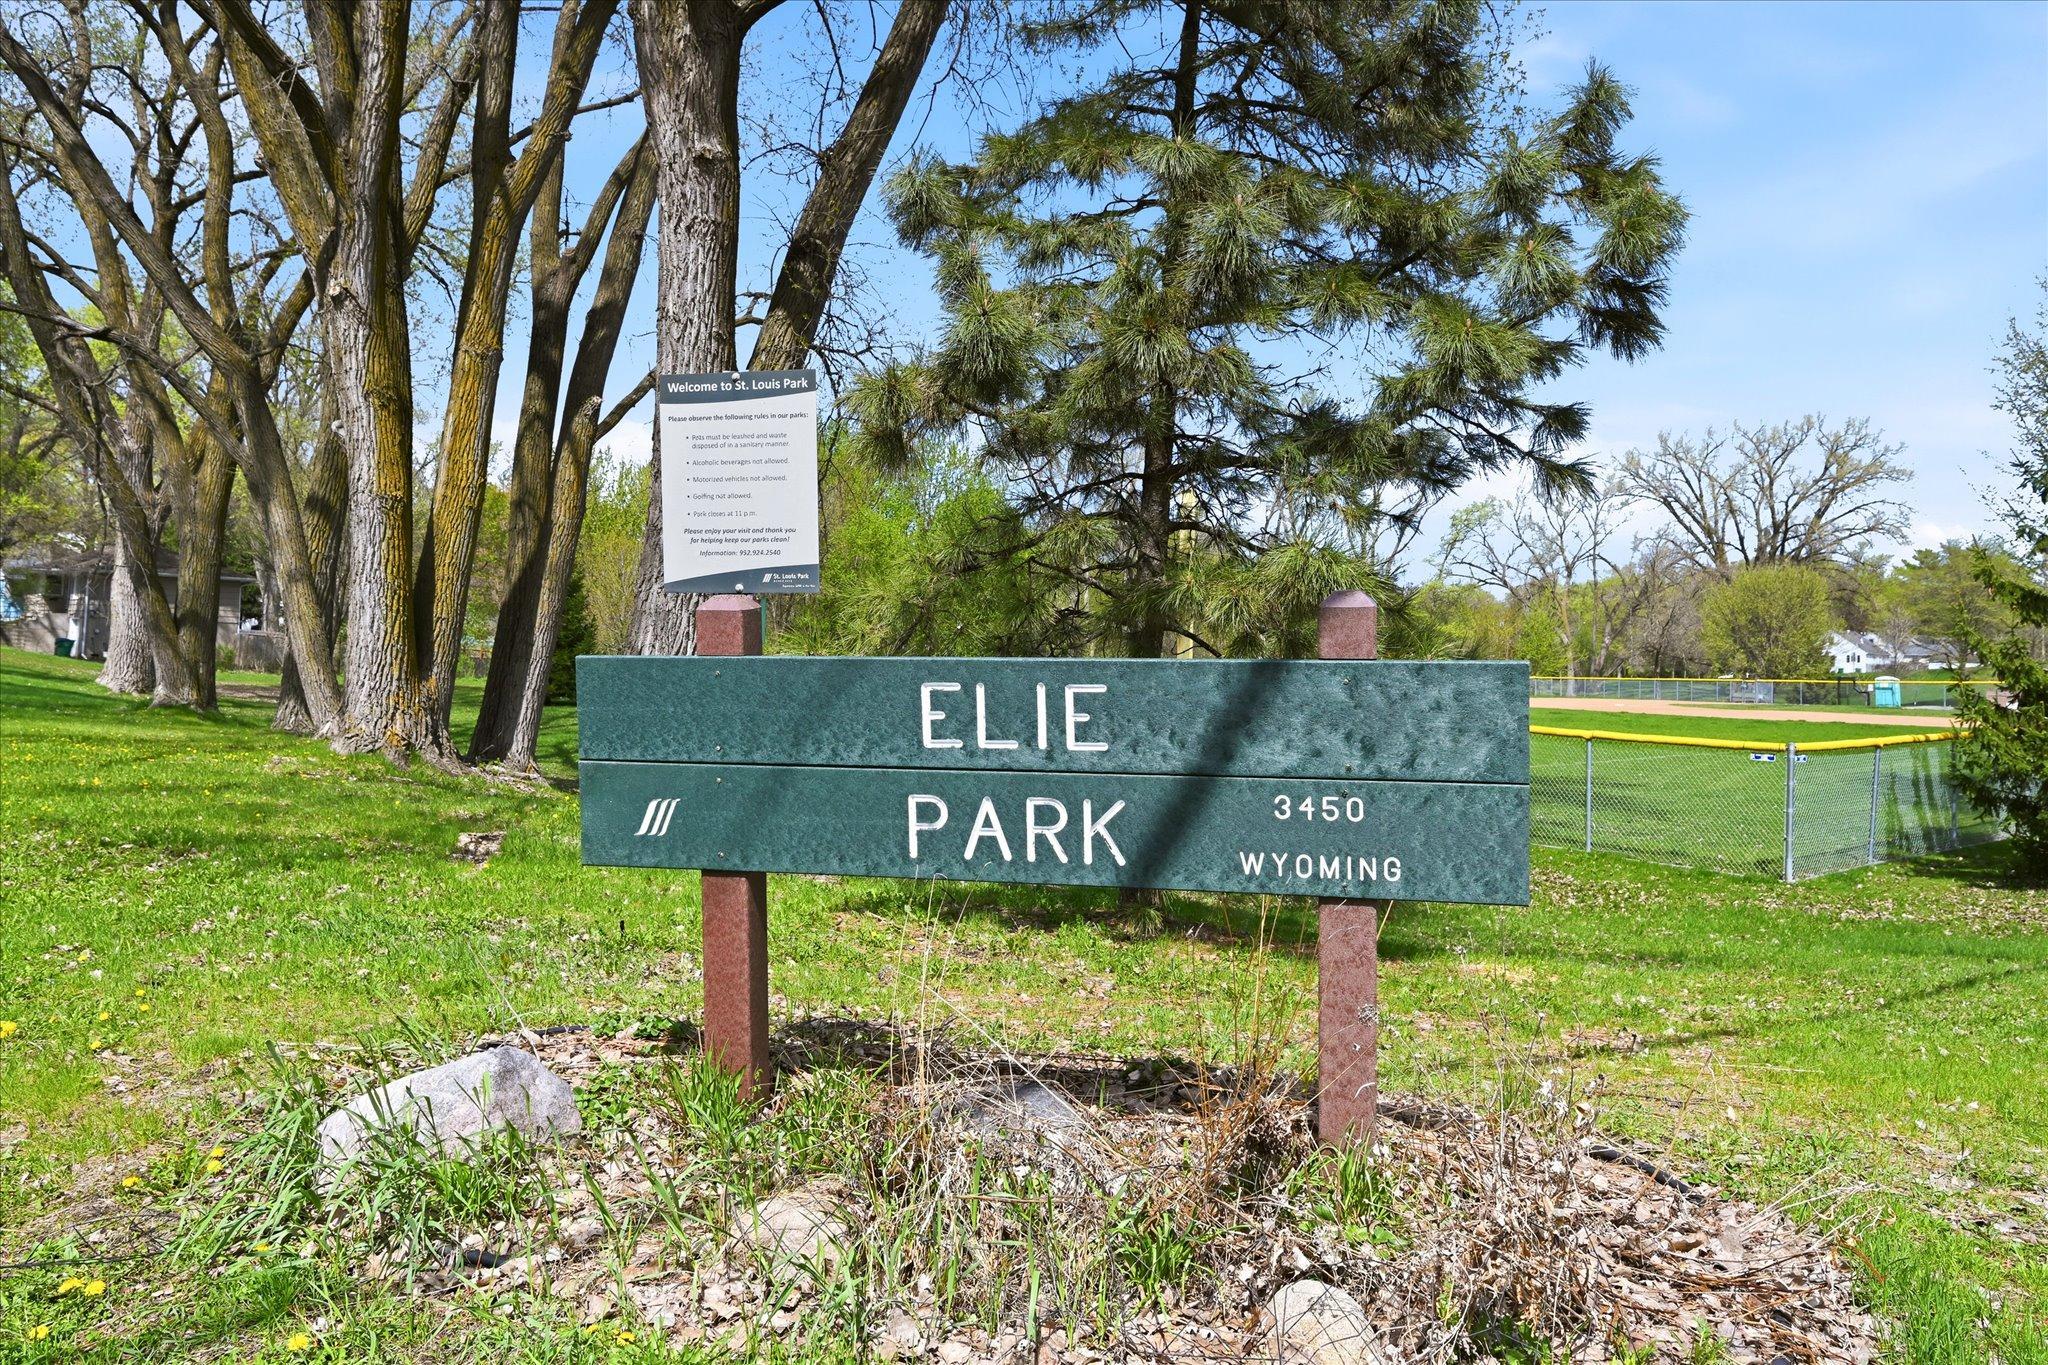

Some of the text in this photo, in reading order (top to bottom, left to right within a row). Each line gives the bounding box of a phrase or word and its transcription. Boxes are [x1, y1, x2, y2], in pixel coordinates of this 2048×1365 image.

[667, 378, 808, 393] Welcome to St. Louis Park
[790, 412, 809, 420] parks:
[691, 442, 718, 450] disposed
[740, 441, 764, 449] sanitary
[720, 459, 751, 467] beverages
[692, 493, 714, 501] Golfing
[752, 536, 770, 544] parks
[699, 550, 737, 558] Information:
[921, 682, 1109, 752] ELIE
[1273, 794, 1365, 823] 3450
[907, 794, 1127, 868] PARK
[1239, 851, 1402, 882] WYOMING
